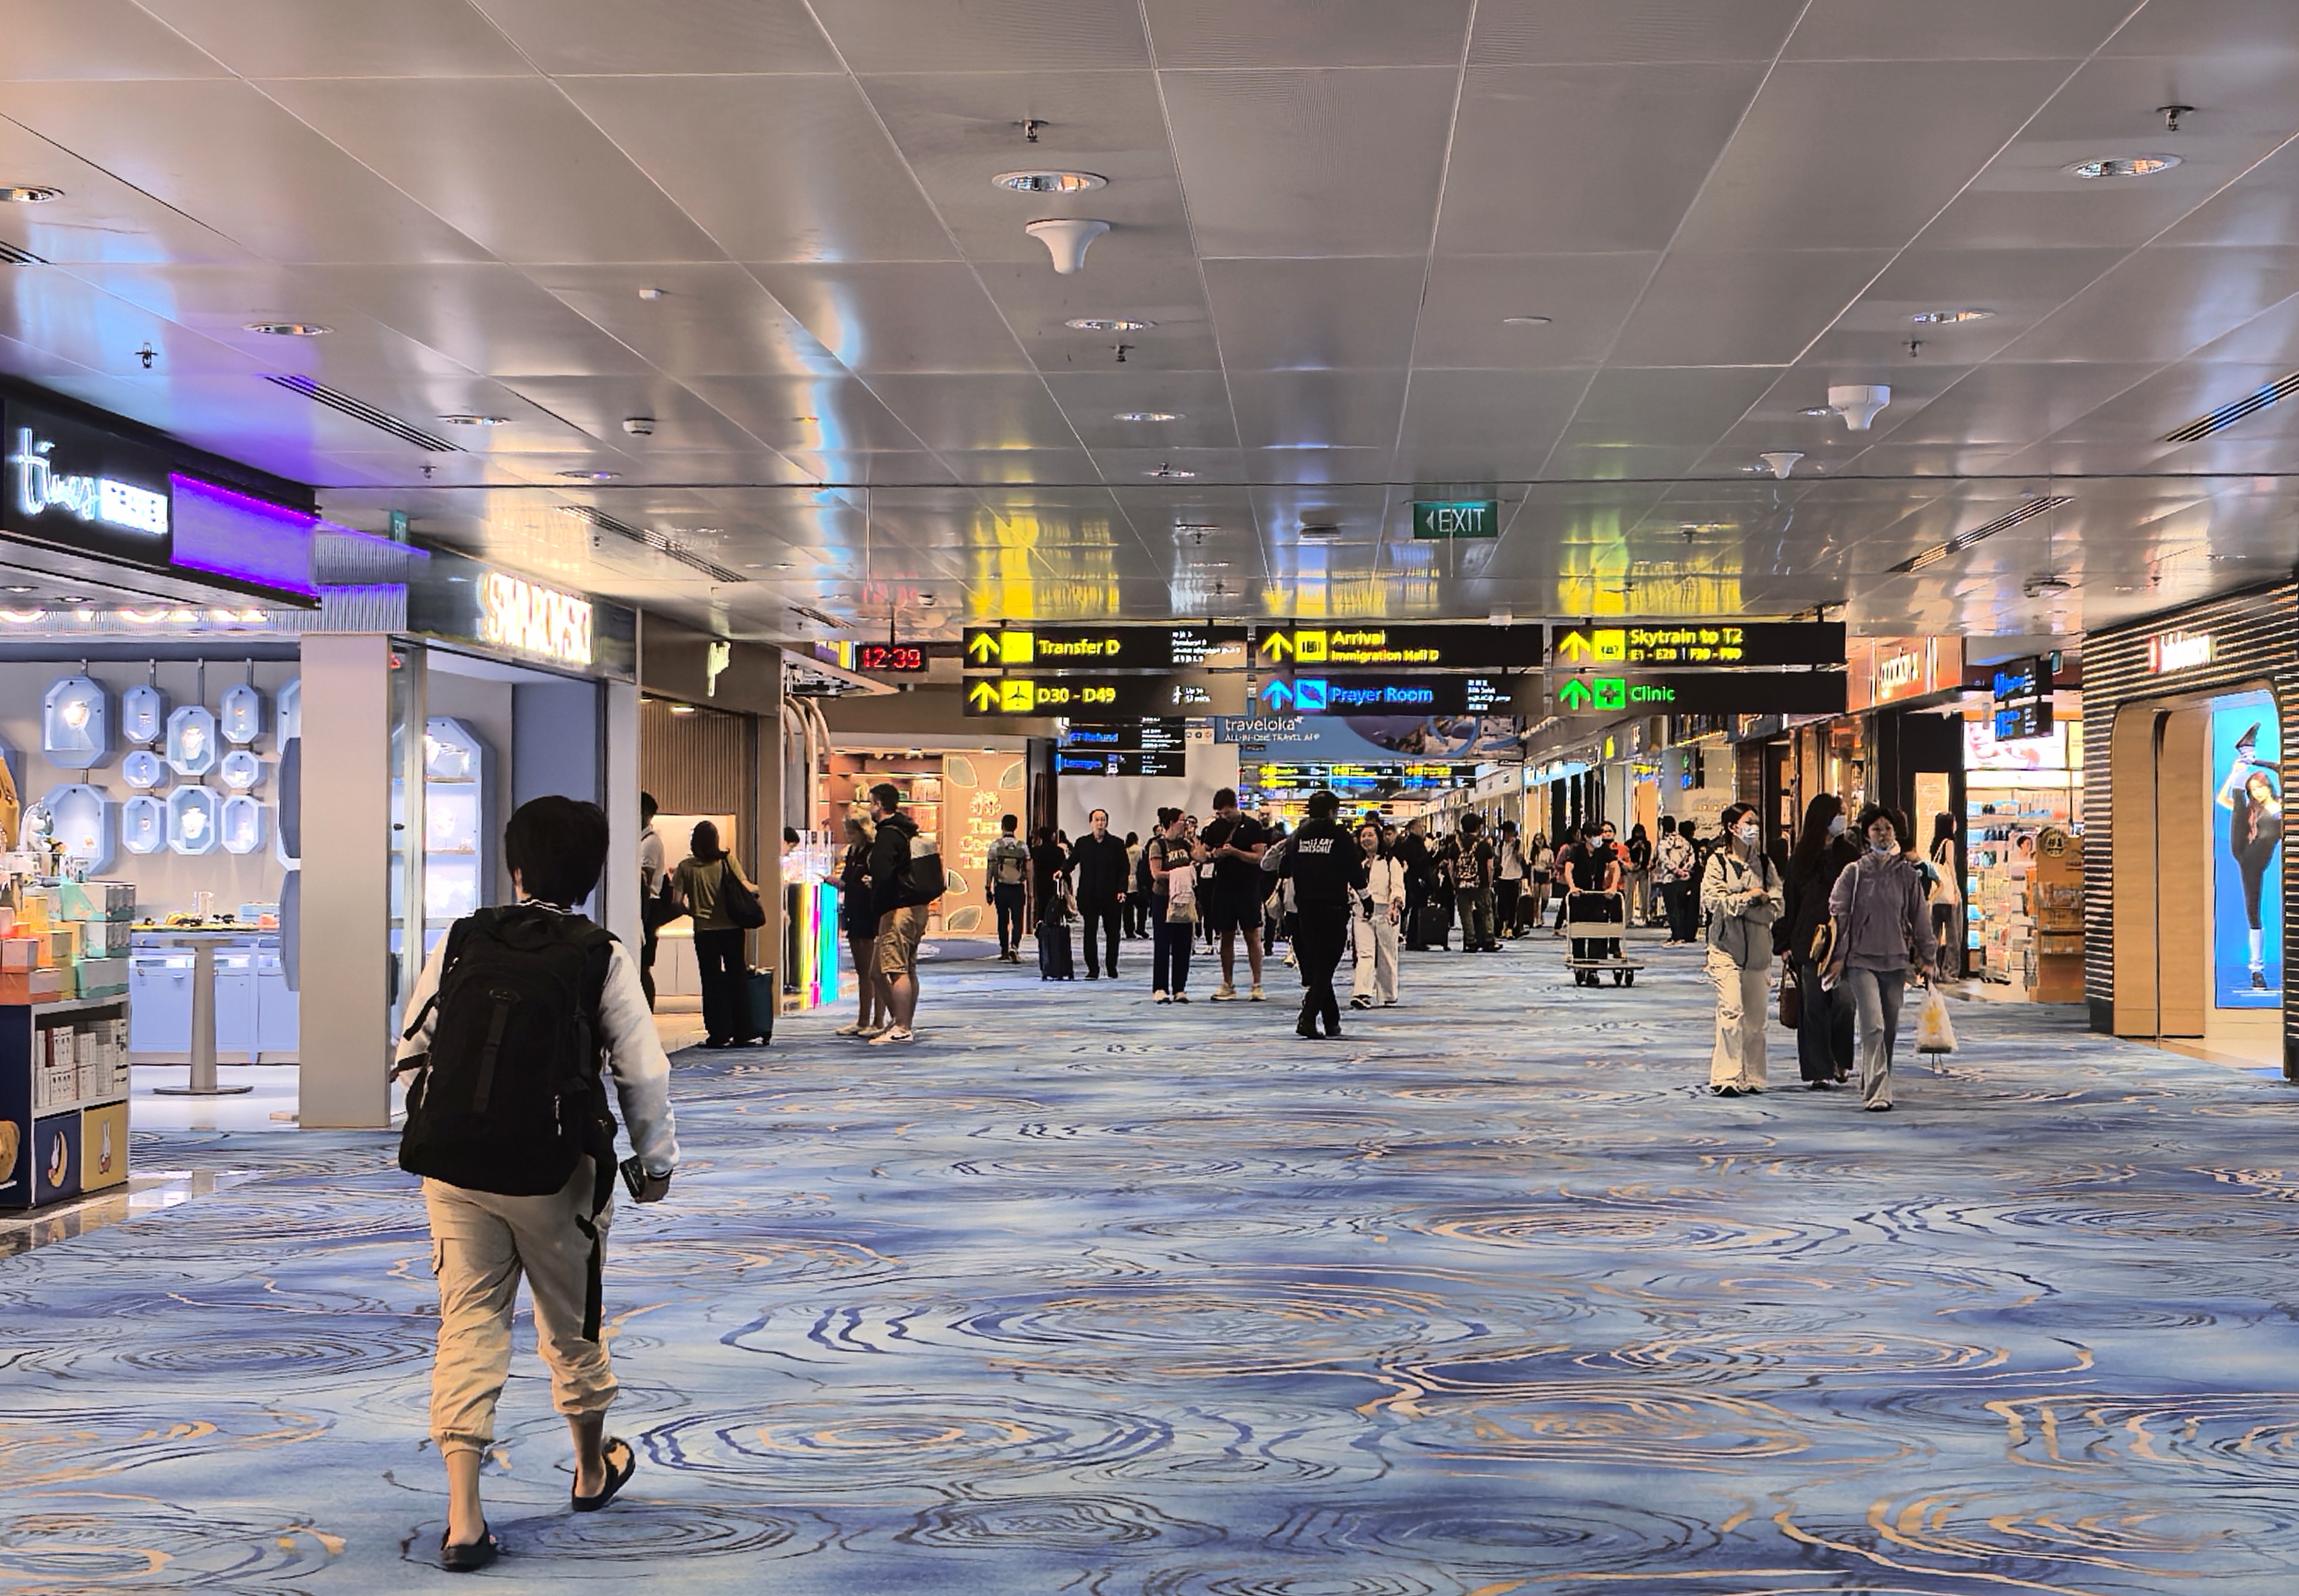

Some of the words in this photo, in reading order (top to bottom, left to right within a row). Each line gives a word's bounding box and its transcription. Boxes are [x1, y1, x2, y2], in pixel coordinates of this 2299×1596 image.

[1438, 508, 1485, 532] EXIT
[1332, 629, 1385, 645] Arrival
[1630, 628, 1696, 647] Skytrain
[1700, 629, 1719, 644] to
[1722, 627, 1743, 644] T2
[1038, 639, 1104, 655] Transfer
[1106, 639, 1120, 655] D
[1331, 650, 1402, 663] Immigration
[1403, 649, 1427, 661] Hall
[1037, 688, 1069, 703] D30
[1083, 688, 1116, 703] D49
[1330, 687, 1382, 706] Prayer
[1384, 686, 1433, 702] Room
[1630, 686, 1675, 701] Clinic
[1225, 716, 1295, 731] traveloka
[1272, 733, 1302, 742] TRAVEL
